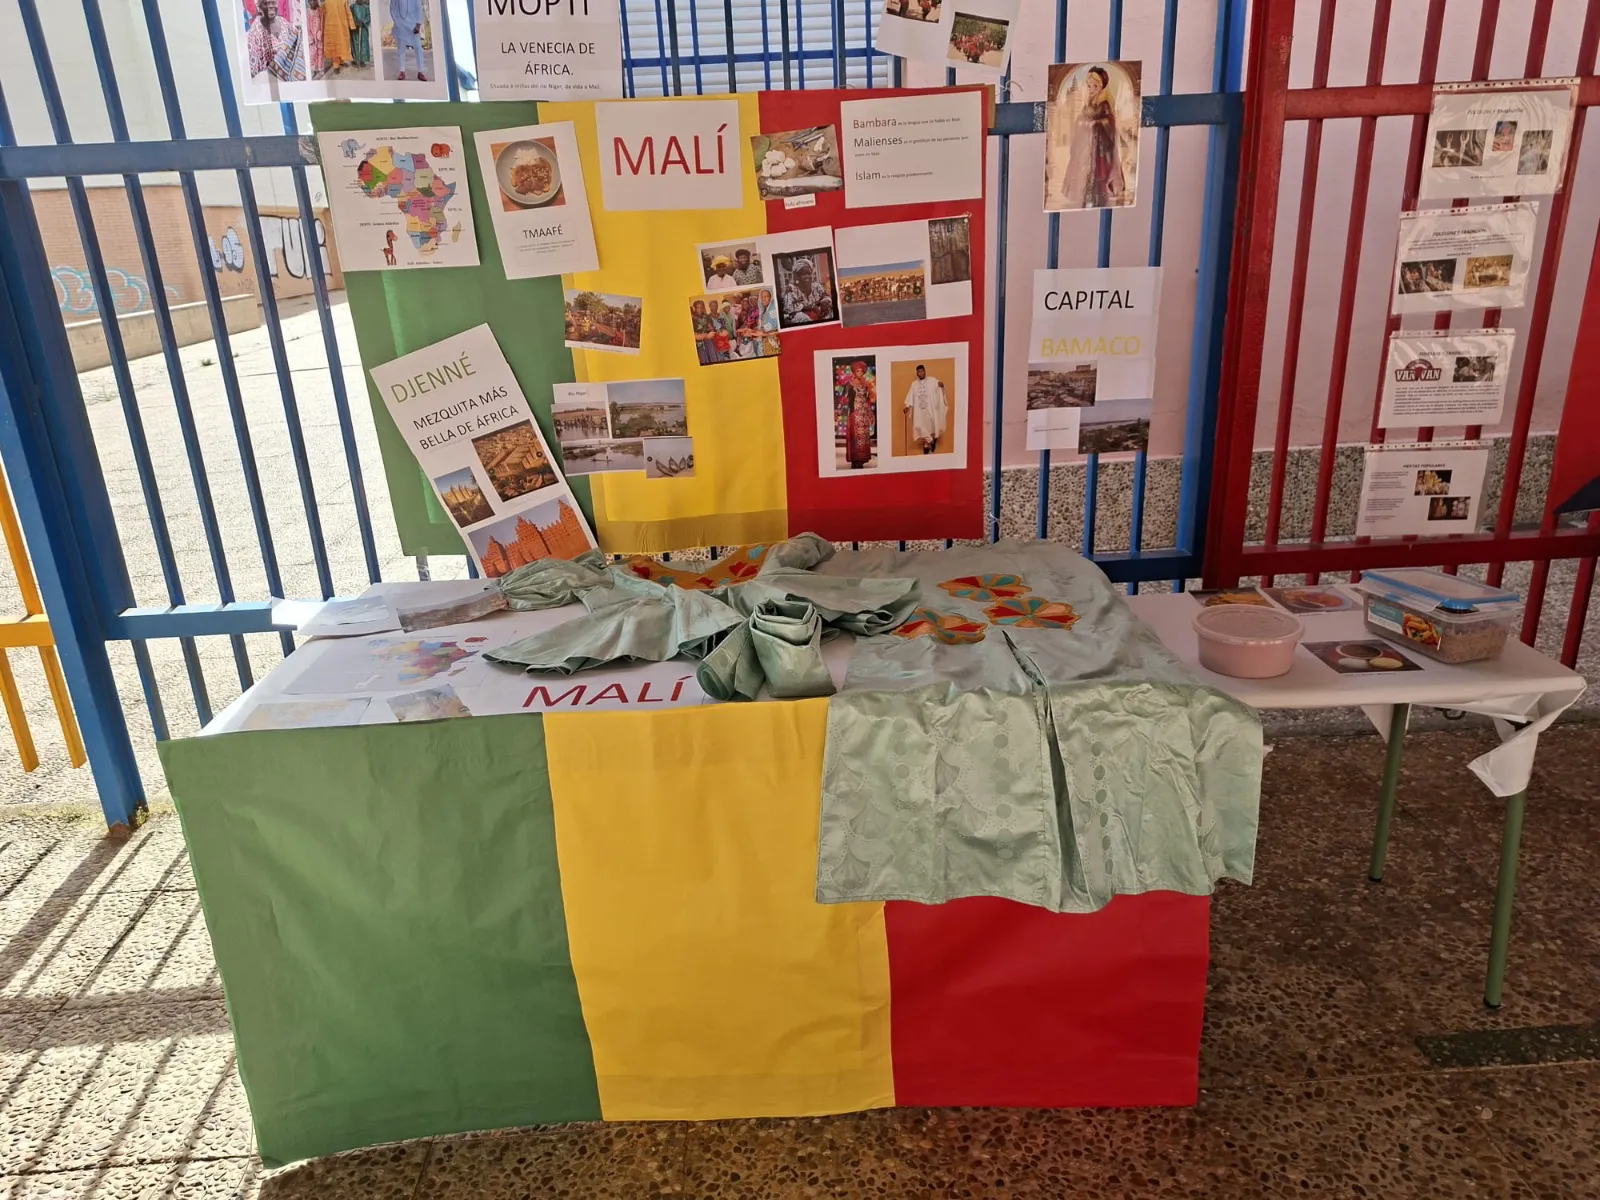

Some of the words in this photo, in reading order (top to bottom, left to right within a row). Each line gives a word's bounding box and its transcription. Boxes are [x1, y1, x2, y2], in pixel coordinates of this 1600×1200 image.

[501, 42, 516, 54] LA
[520, 42, 575, 54] VENECIA
[579, 42, 596, 54] DE
[524, 60, 574, 76] ÁFRICA.
[853, 118, 897, 128] Bambara
[614, 124, 728, 176] MALÍ
[854, 136, 903, 148] Malienses
[855, 170, 880, 180] Islam
[523, 224, 564, 238] TMAAFÉ
[1044, 290, 1135, 310] CAPITAL
[1040, 336, 1141, 357] BAMACO
[390, 350, 476, 403] DJENNÉ
[1420, 369, 1440, 380] VAN
[413, 398, 478, 430] MEZQUITA
[478, 386, 508, 405] MÁS
[420, 430, 456, 450] BELLA
[456, 421, 474, 436] DE
[477, 405, 519, 429] ÁFRICA
[522, 675, 694, 708] MALÍ
